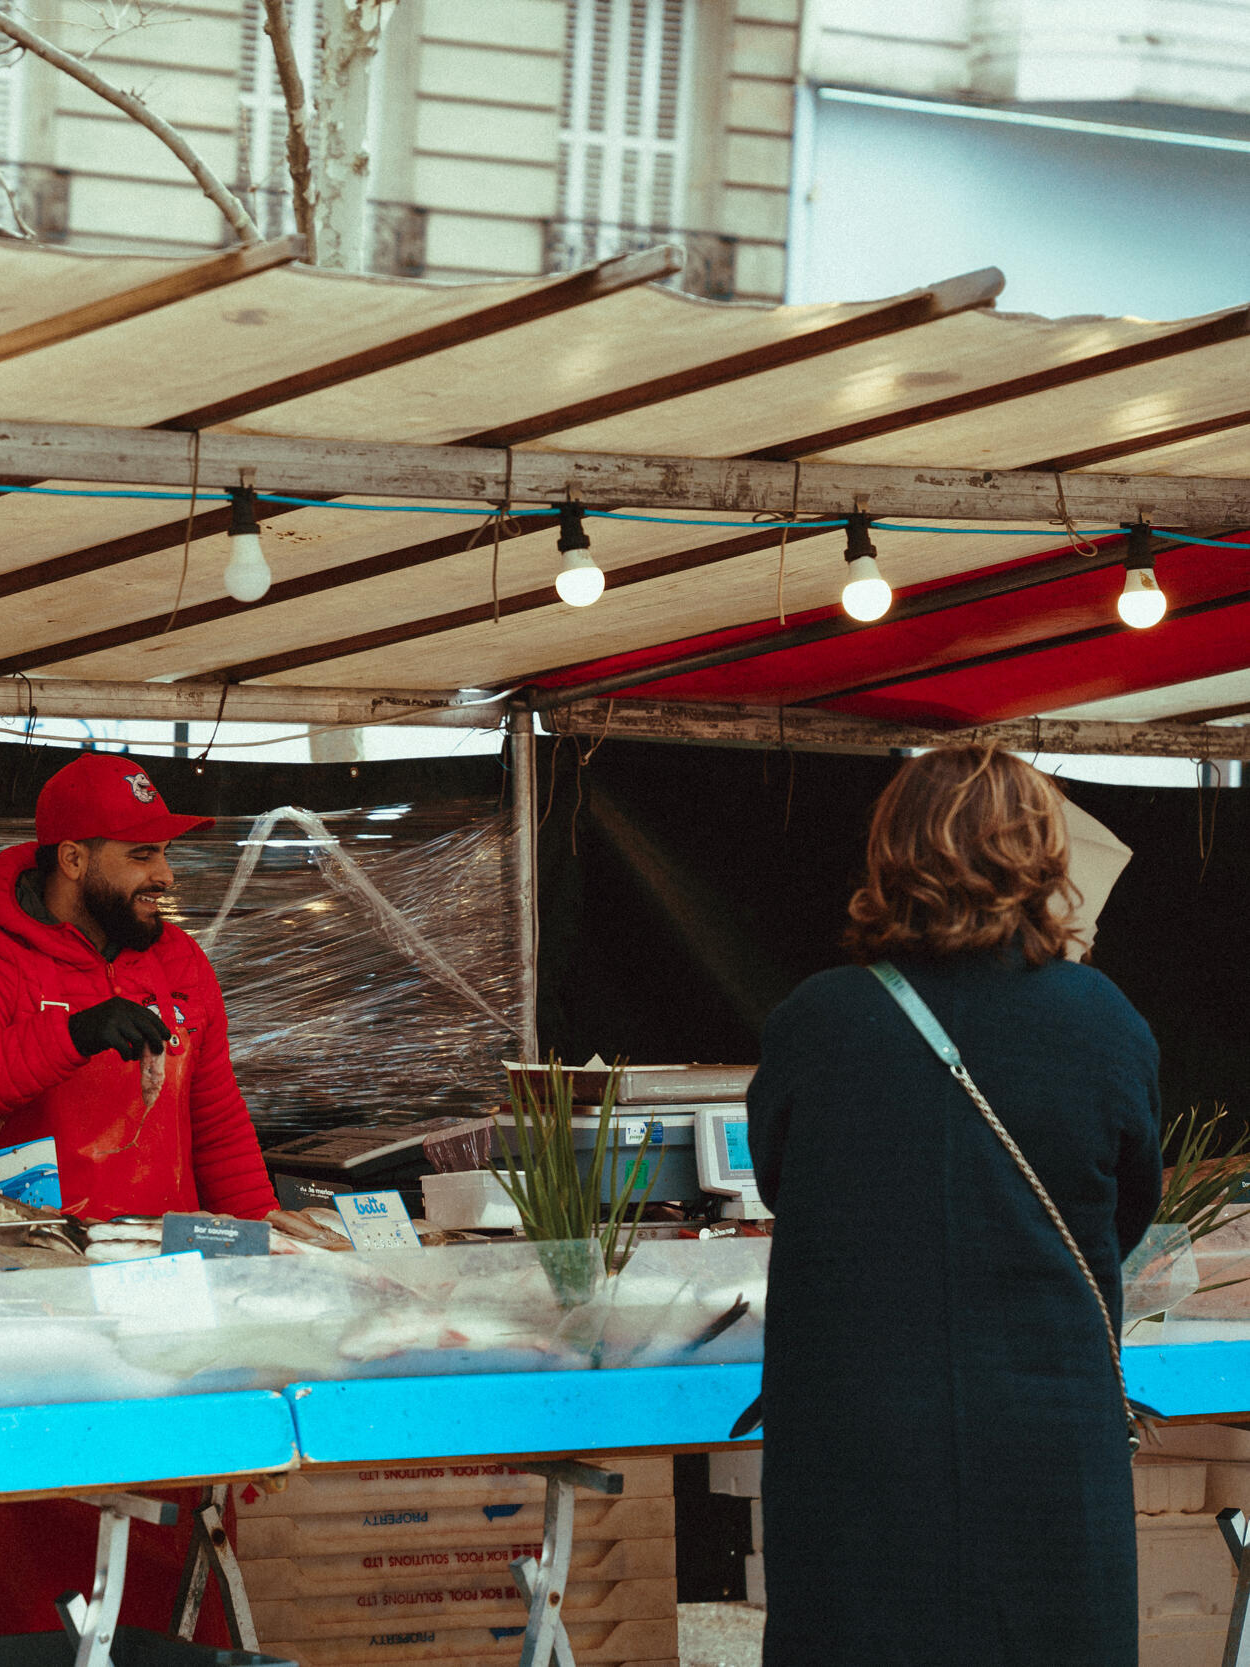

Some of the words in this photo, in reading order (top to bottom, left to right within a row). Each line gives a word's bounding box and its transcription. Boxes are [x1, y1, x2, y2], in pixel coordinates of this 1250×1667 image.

[362, 1511, 430, 1527] PROPERTY
[388, 1553, 450, 1568] SOLUTIONS
[455, 1551, 485, 1564] POOL
[487, 1550, 509, 1561] BOX
[362, 1556, 384, 1569] LTD
[382, 1591, 444, 1607] SOLUTIONS
[448, 1589, 479, 1602] POOL
[479, 1588, 503, 1600] BOX
[357, 1595, 379, 1608] LTD
[368, 1631, 436, 1647] PROPERTY
